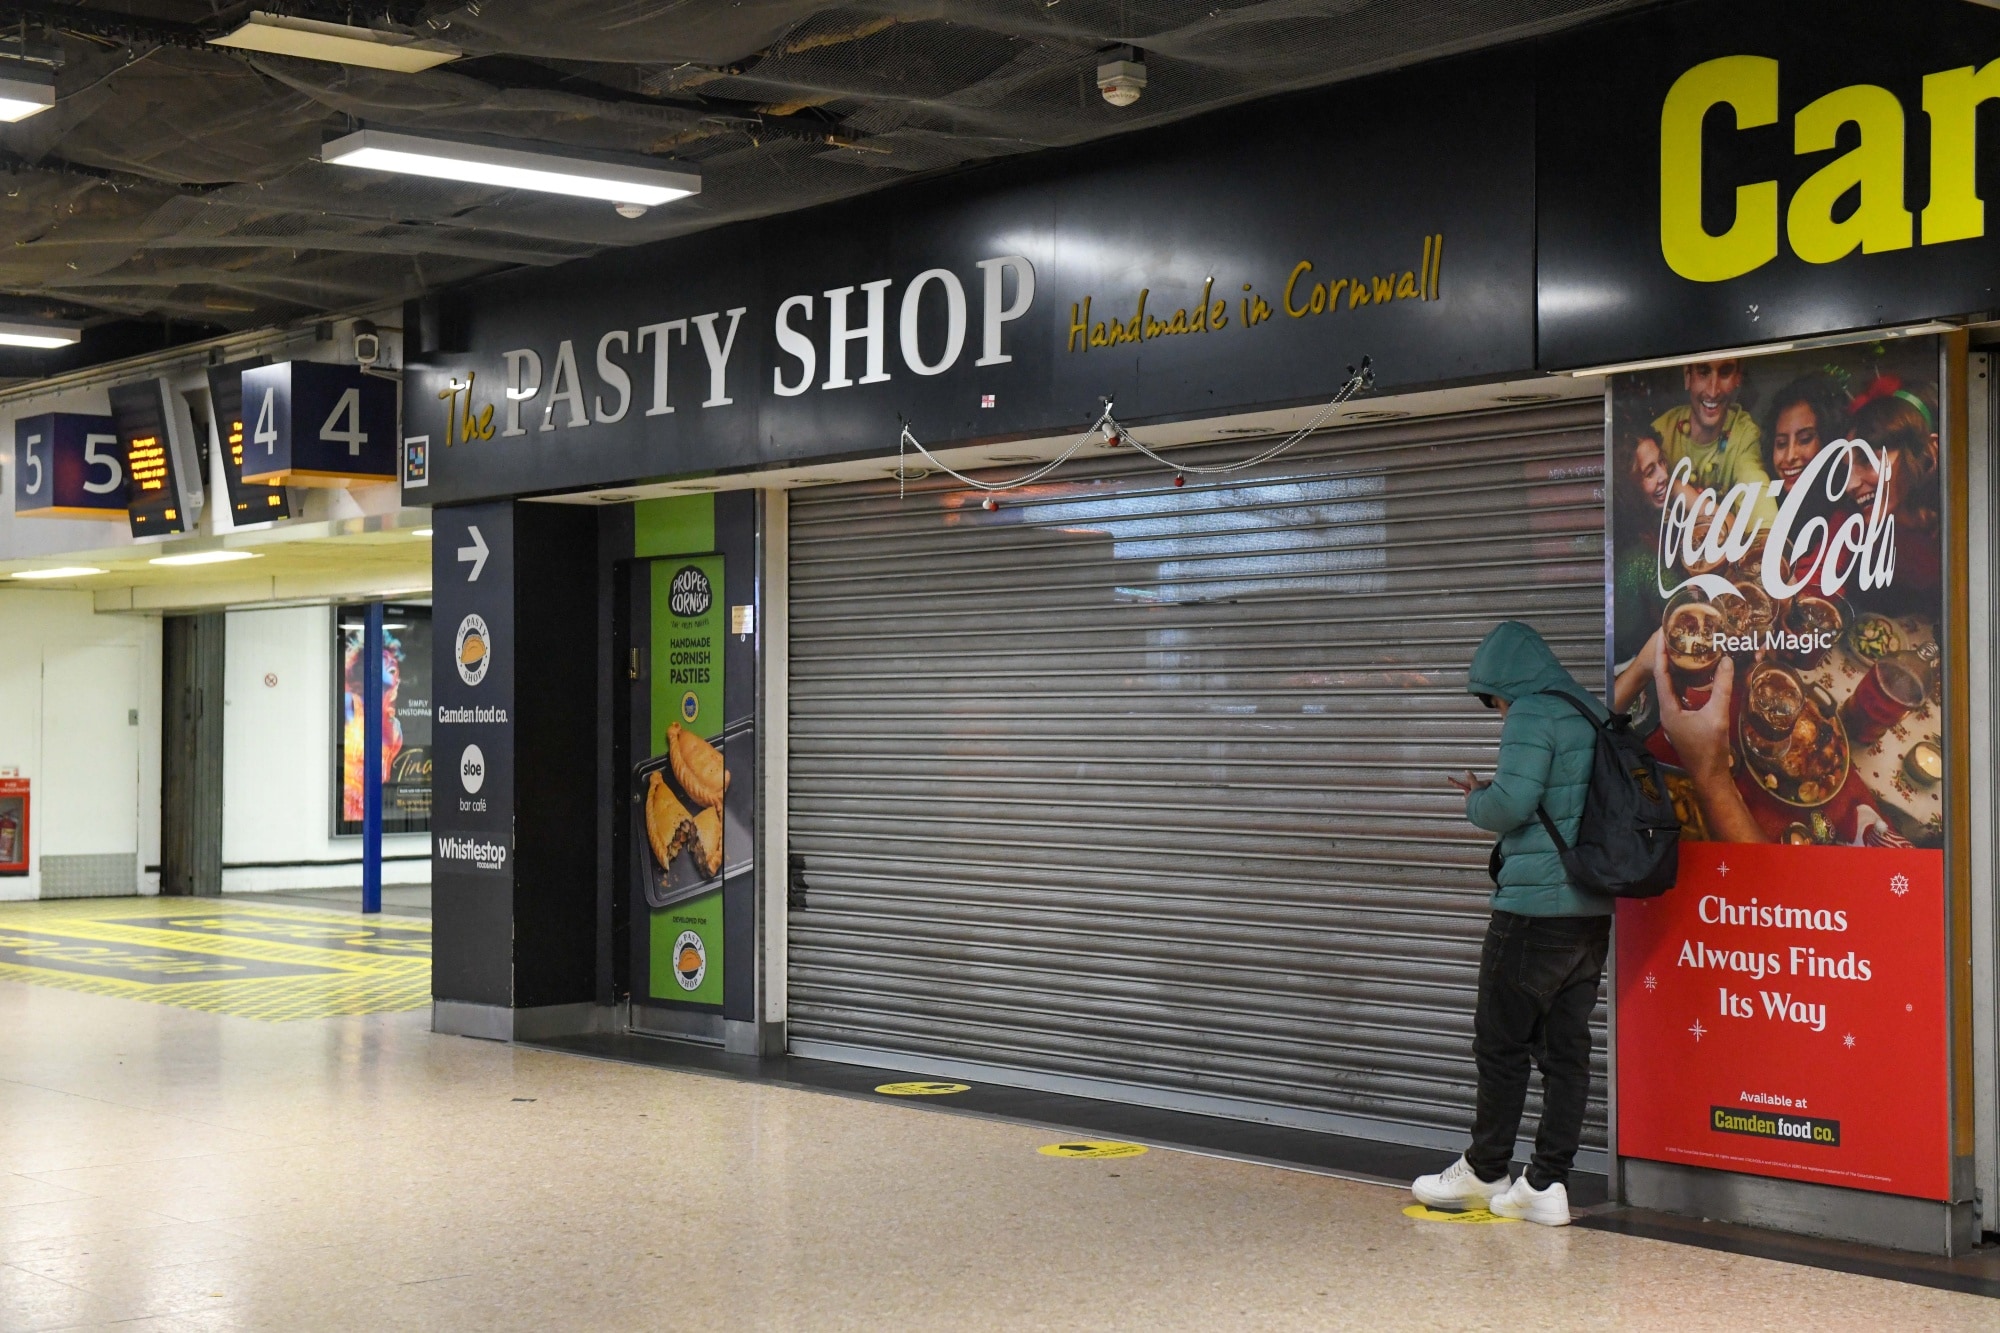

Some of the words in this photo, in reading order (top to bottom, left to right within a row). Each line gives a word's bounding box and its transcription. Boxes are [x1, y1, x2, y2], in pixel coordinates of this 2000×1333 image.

[1068, 276, 1229, 353] Handmade
[1240, 283, 1272, 328] in
[1283, 233, 1443, 318] Cornwall
[438, 371, 496, 448] The
[502, 307, 747, 438] PASTY
[773, 255, 1036, 397] SHOP
[254, 388, 277, 455] 4
[319, 388, 368, 455] 4
[26, 434, 42, 495] 5
[83, 433, 123, 494] 5
[1658, 438, 1896, 601] Coca-Cola
[672, 570, 708, 593] PROPER
[467, 617, 487, 637] PASTY
[670, 637, 711, 649] HANDMADE
[1713, 631, 1760, 653] Real
[670, 651, 711, 666] CORNISH
[463, 670, 482, 683] SHOP
[670, 668, 711, 685] PASTIES
[408, 699, 428, 708] SIMPLY
[438, 705, 474, 723] Camden
[475, 705, 495, 723] food
[495, 708, 508, 723] co.
[463, 759, 482, 776] sloe
[459, 797, 471, 811] bar
[472, 798, 487, 812] café
[438, 836, 506, 869] Whistlestop
[1698, 895, 1848, 932] Christmas
[682, 933, 703, 951] PASTY
[1676, 940, 1781, 980] Always
[1789, 946, 1872, 981] Finds
[681, 976, 698, 989] SHOP
[1718, 987, 1754, 1019] Its
[1759, 990, 1826, 1032] Way
[1739, 1090, 1792, 1107] Available
[1795, 1098, 1808, 1109] at
[1714, 1110, 1776, 1135] Camden
[1778, 1117, 1811, 1139] food
[1813, 1125, 1835, 1142] co.
